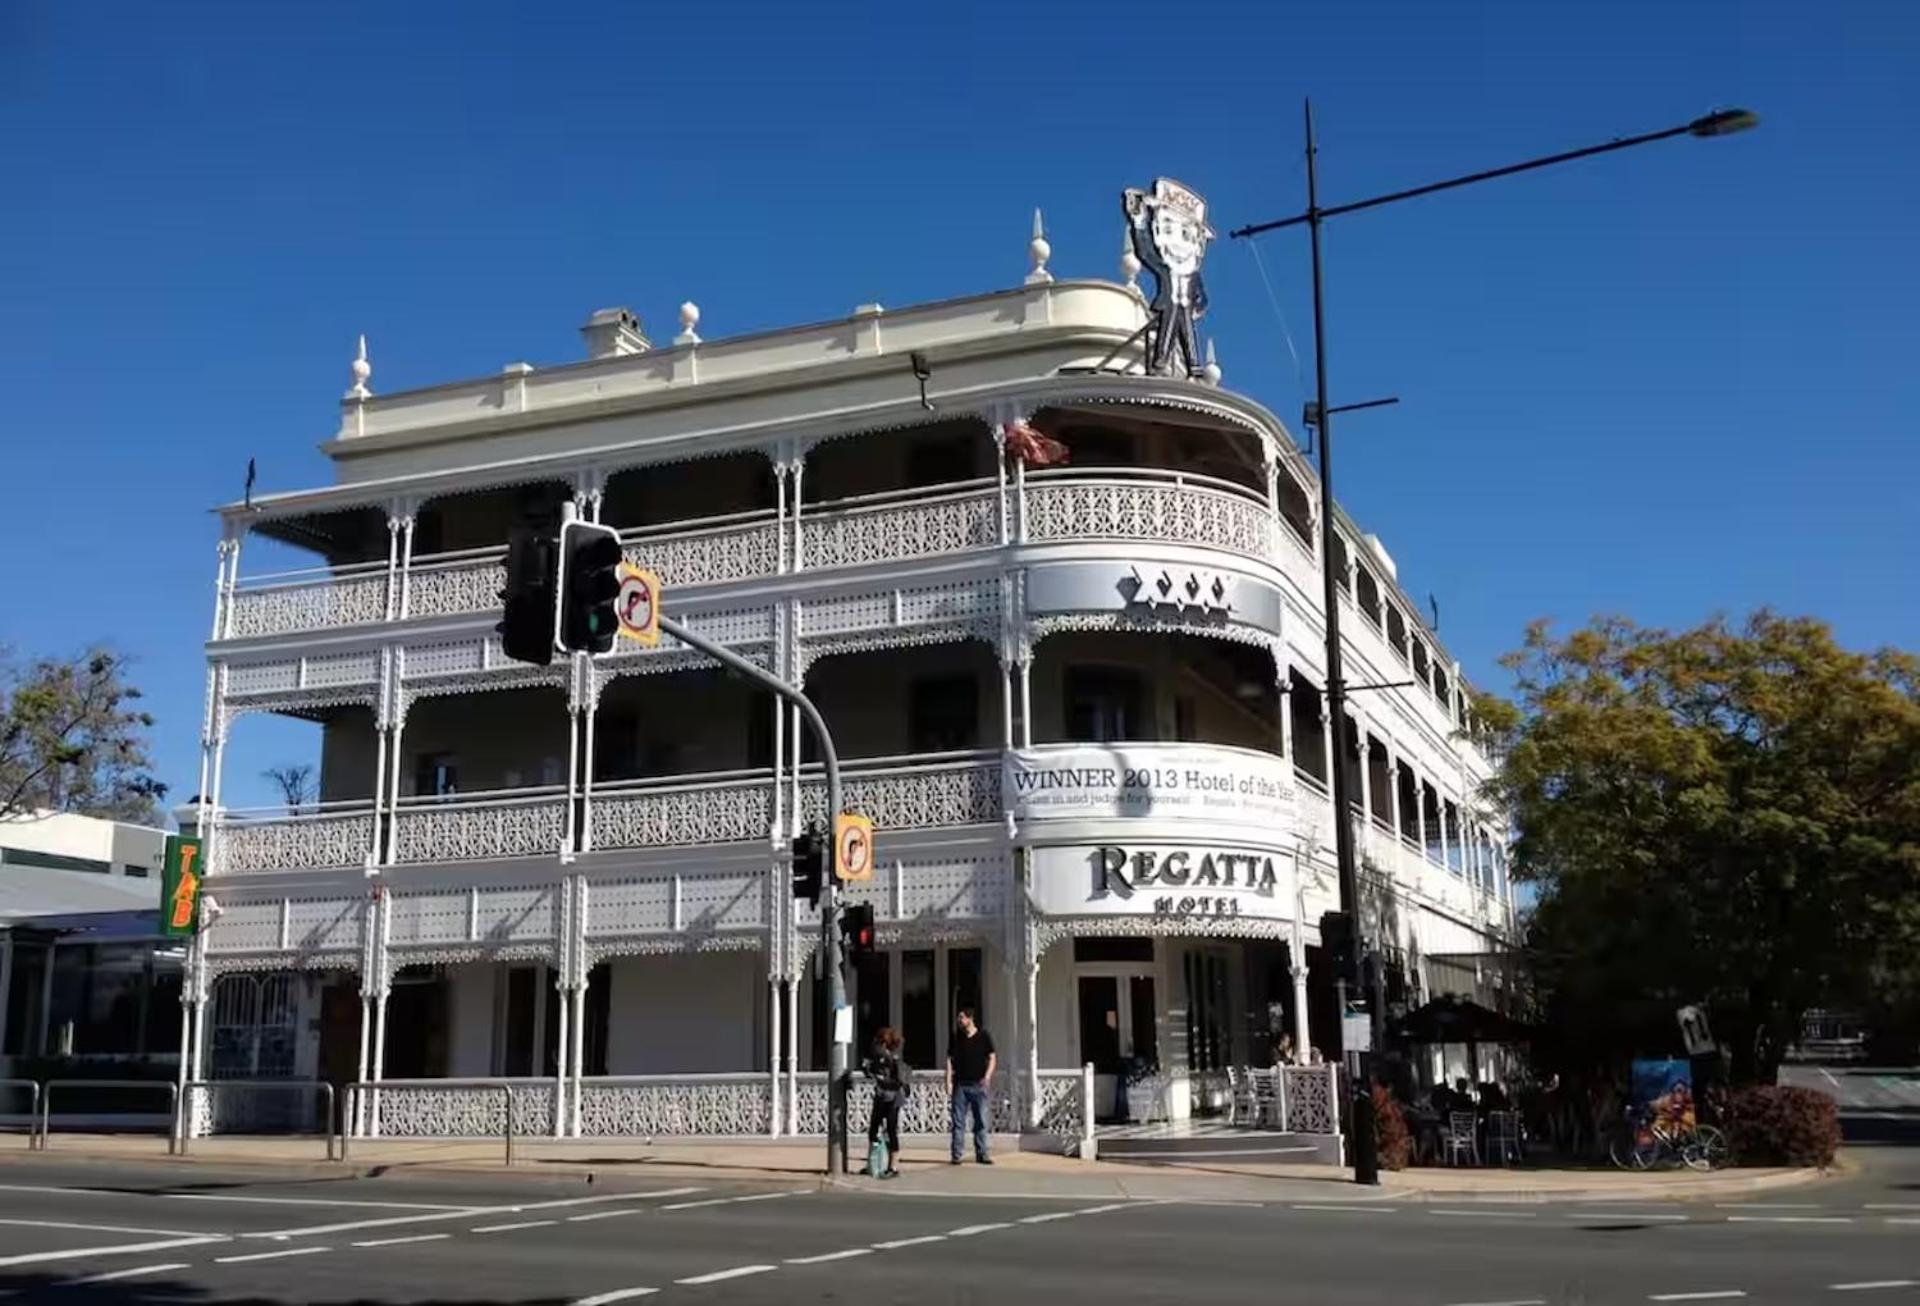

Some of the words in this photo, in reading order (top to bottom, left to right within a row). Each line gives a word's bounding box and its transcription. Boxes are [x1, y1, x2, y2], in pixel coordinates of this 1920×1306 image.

[1014, 767, 1116, 791] WINNER
[1123, 767, 1178, 789] 2013
[1184, 770, 1234, 792] Hotel
[1239, 774, 1254, 795] of
[1257, 776, 1276, 798] the
[172, 845, 198, 927] TAB
[1153, 896, 1242, 917] HOTEL
